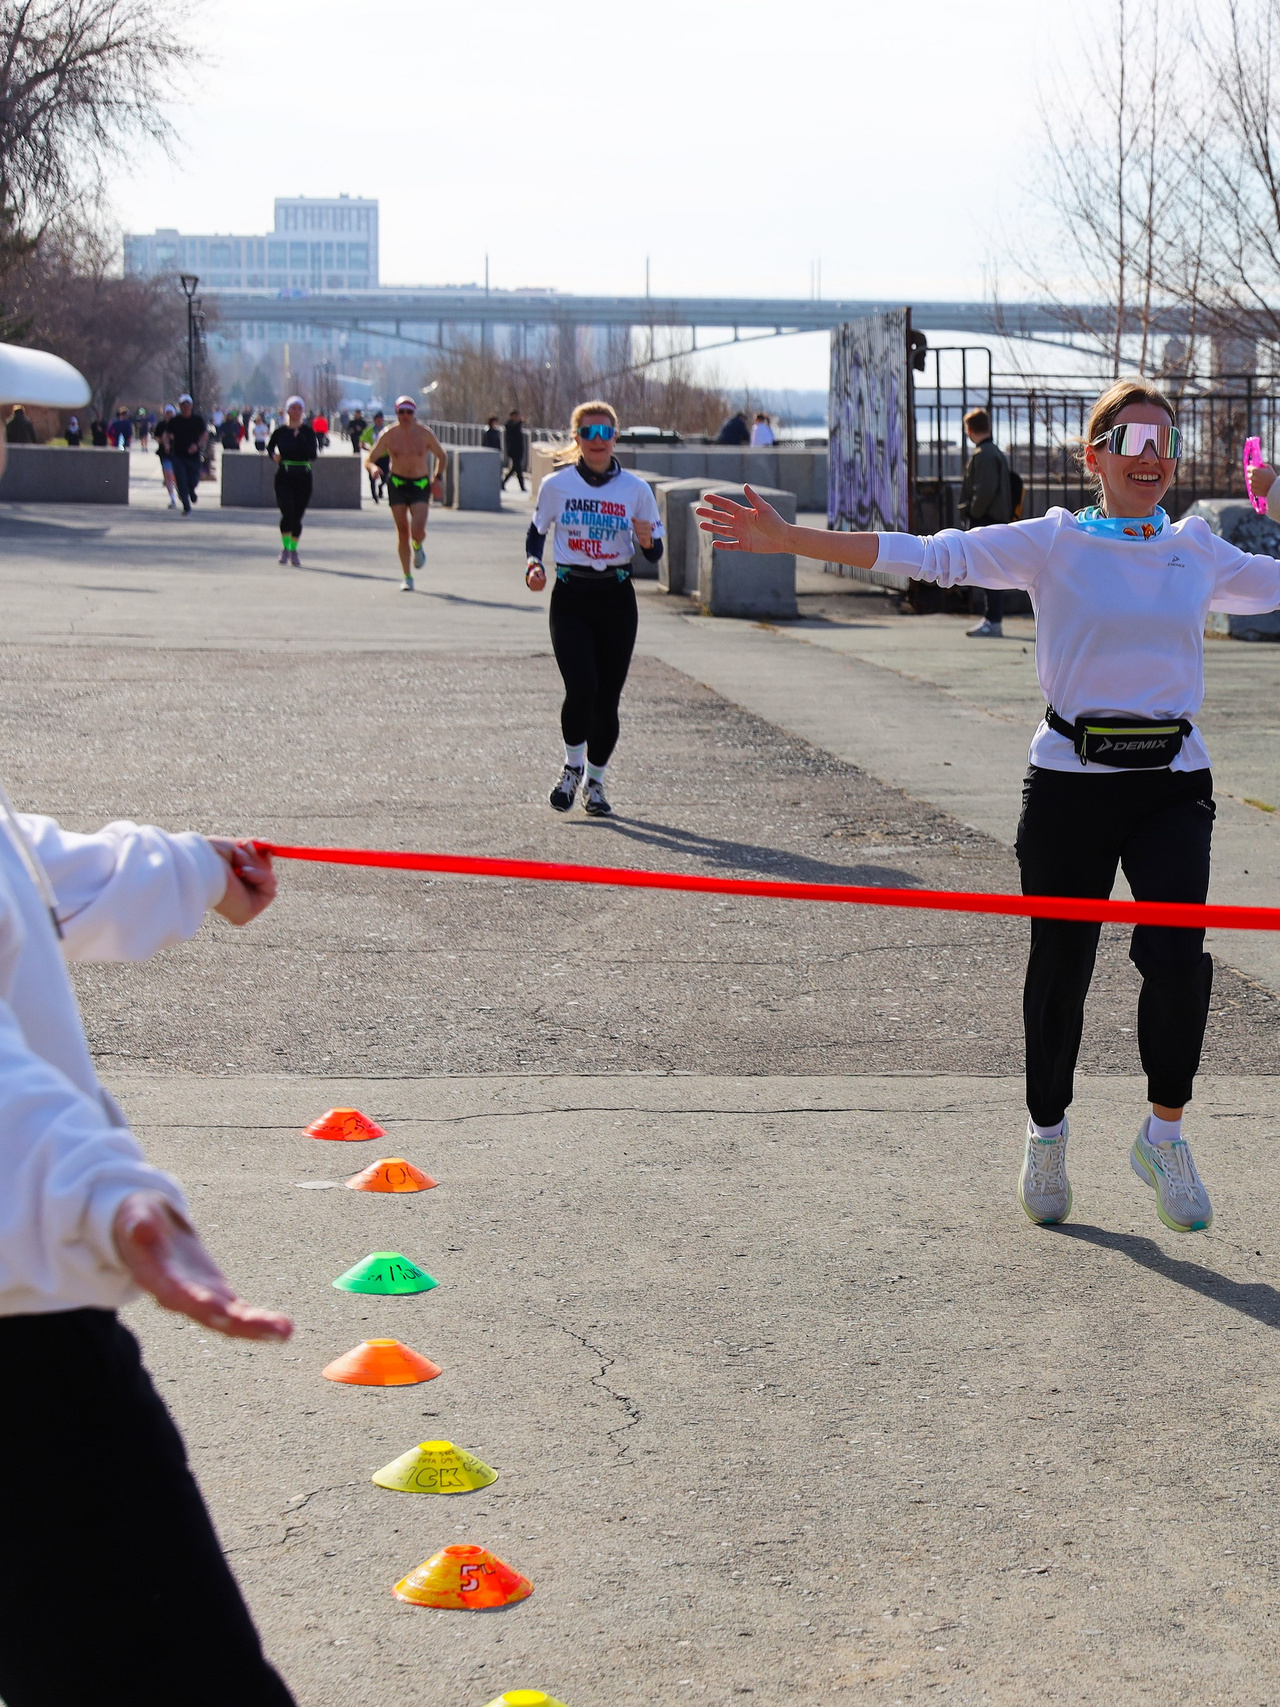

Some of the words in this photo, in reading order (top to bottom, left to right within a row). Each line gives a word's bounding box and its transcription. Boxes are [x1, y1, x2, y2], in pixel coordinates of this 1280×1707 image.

[565, 499, 626, 517] #ЗАБЕГ2025
[582, 512, 629, 531] ПЛАНЕТЫ
[589, 526, 619, 541] БЕГУТ
[568, 538, 602, 554] ВМЕСТЕ
[1113, 739, 1168, 751] DEMIX
